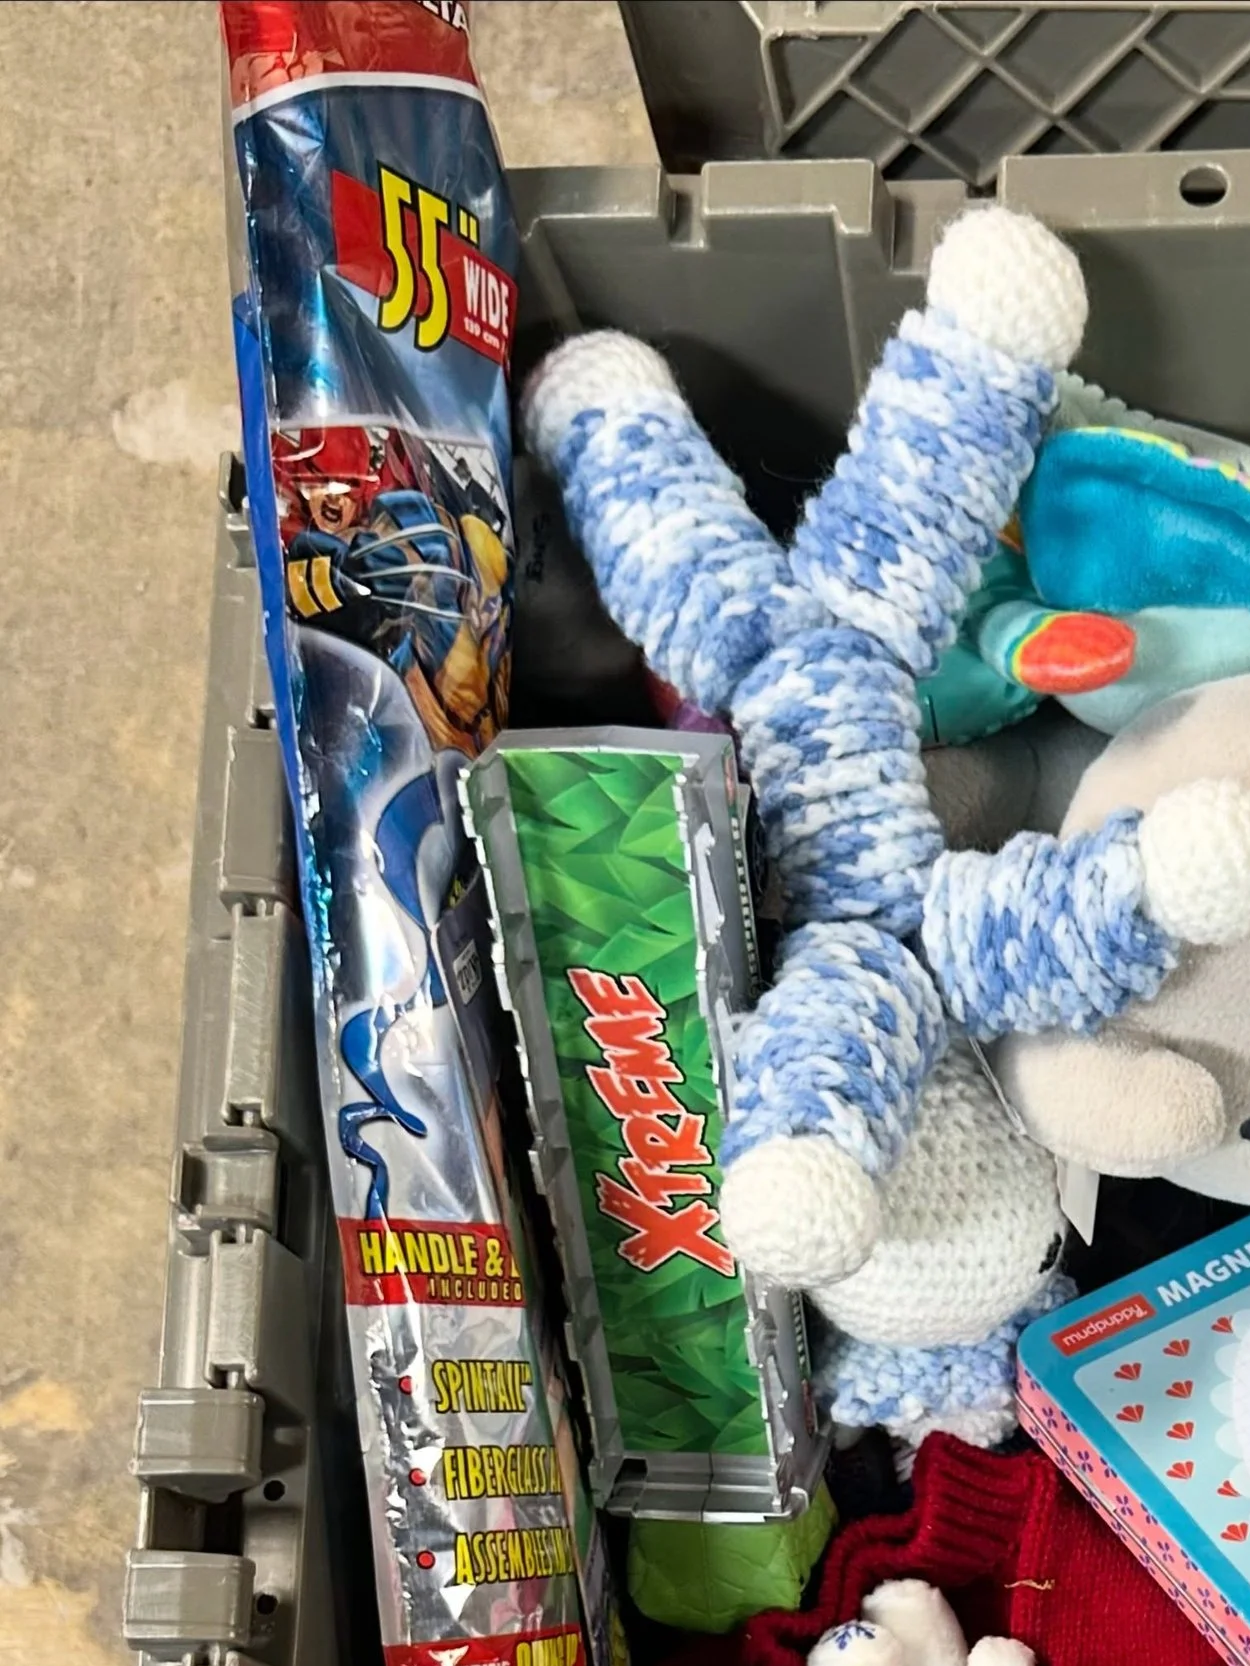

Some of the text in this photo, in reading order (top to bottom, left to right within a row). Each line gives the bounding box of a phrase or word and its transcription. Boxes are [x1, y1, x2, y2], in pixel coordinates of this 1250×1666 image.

[463, 254, 510, 340] WIDE
[566, 967, 737, 1277] XTREME
[358, 1230, 479, 1276] HANDLE
[484, 1236, 504, 1277] &
[429, 1276, 523, 1301] INCLUDED
[1062, 1303, 1149, 1347] mudpuppy
[443, 1445, 547, 1500] FIBERGLASS
[455, 1528, 553, 1586] ASSEMBLES
